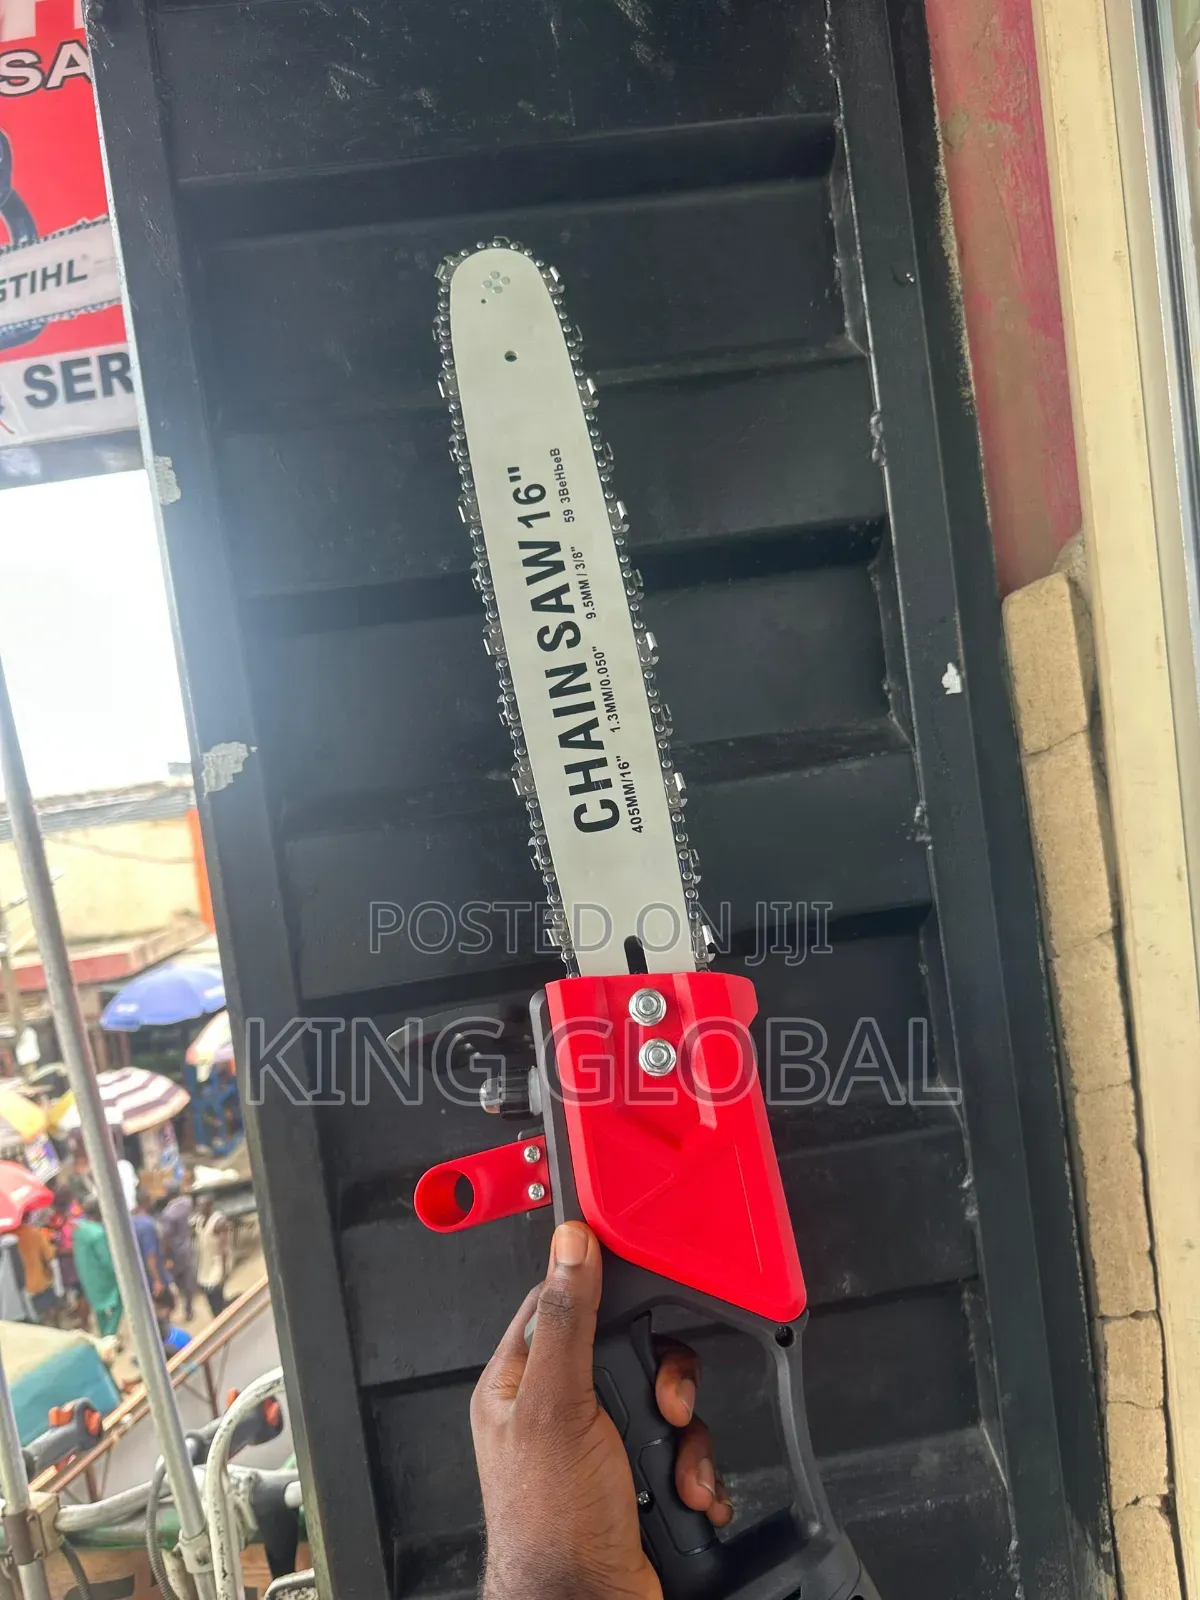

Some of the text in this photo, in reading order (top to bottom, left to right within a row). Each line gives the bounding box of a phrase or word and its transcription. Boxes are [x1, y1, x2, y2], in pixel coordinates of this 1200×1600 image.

[24, 351, 134, 409] SER
[562, 509, 575, 523] 59
[506, 466, 620, 833] CHAIN SAW 16"
[592, 646, 621, 733] 1.3MM/0.050"
[616, 755, 643, 834] 405MM/16"
